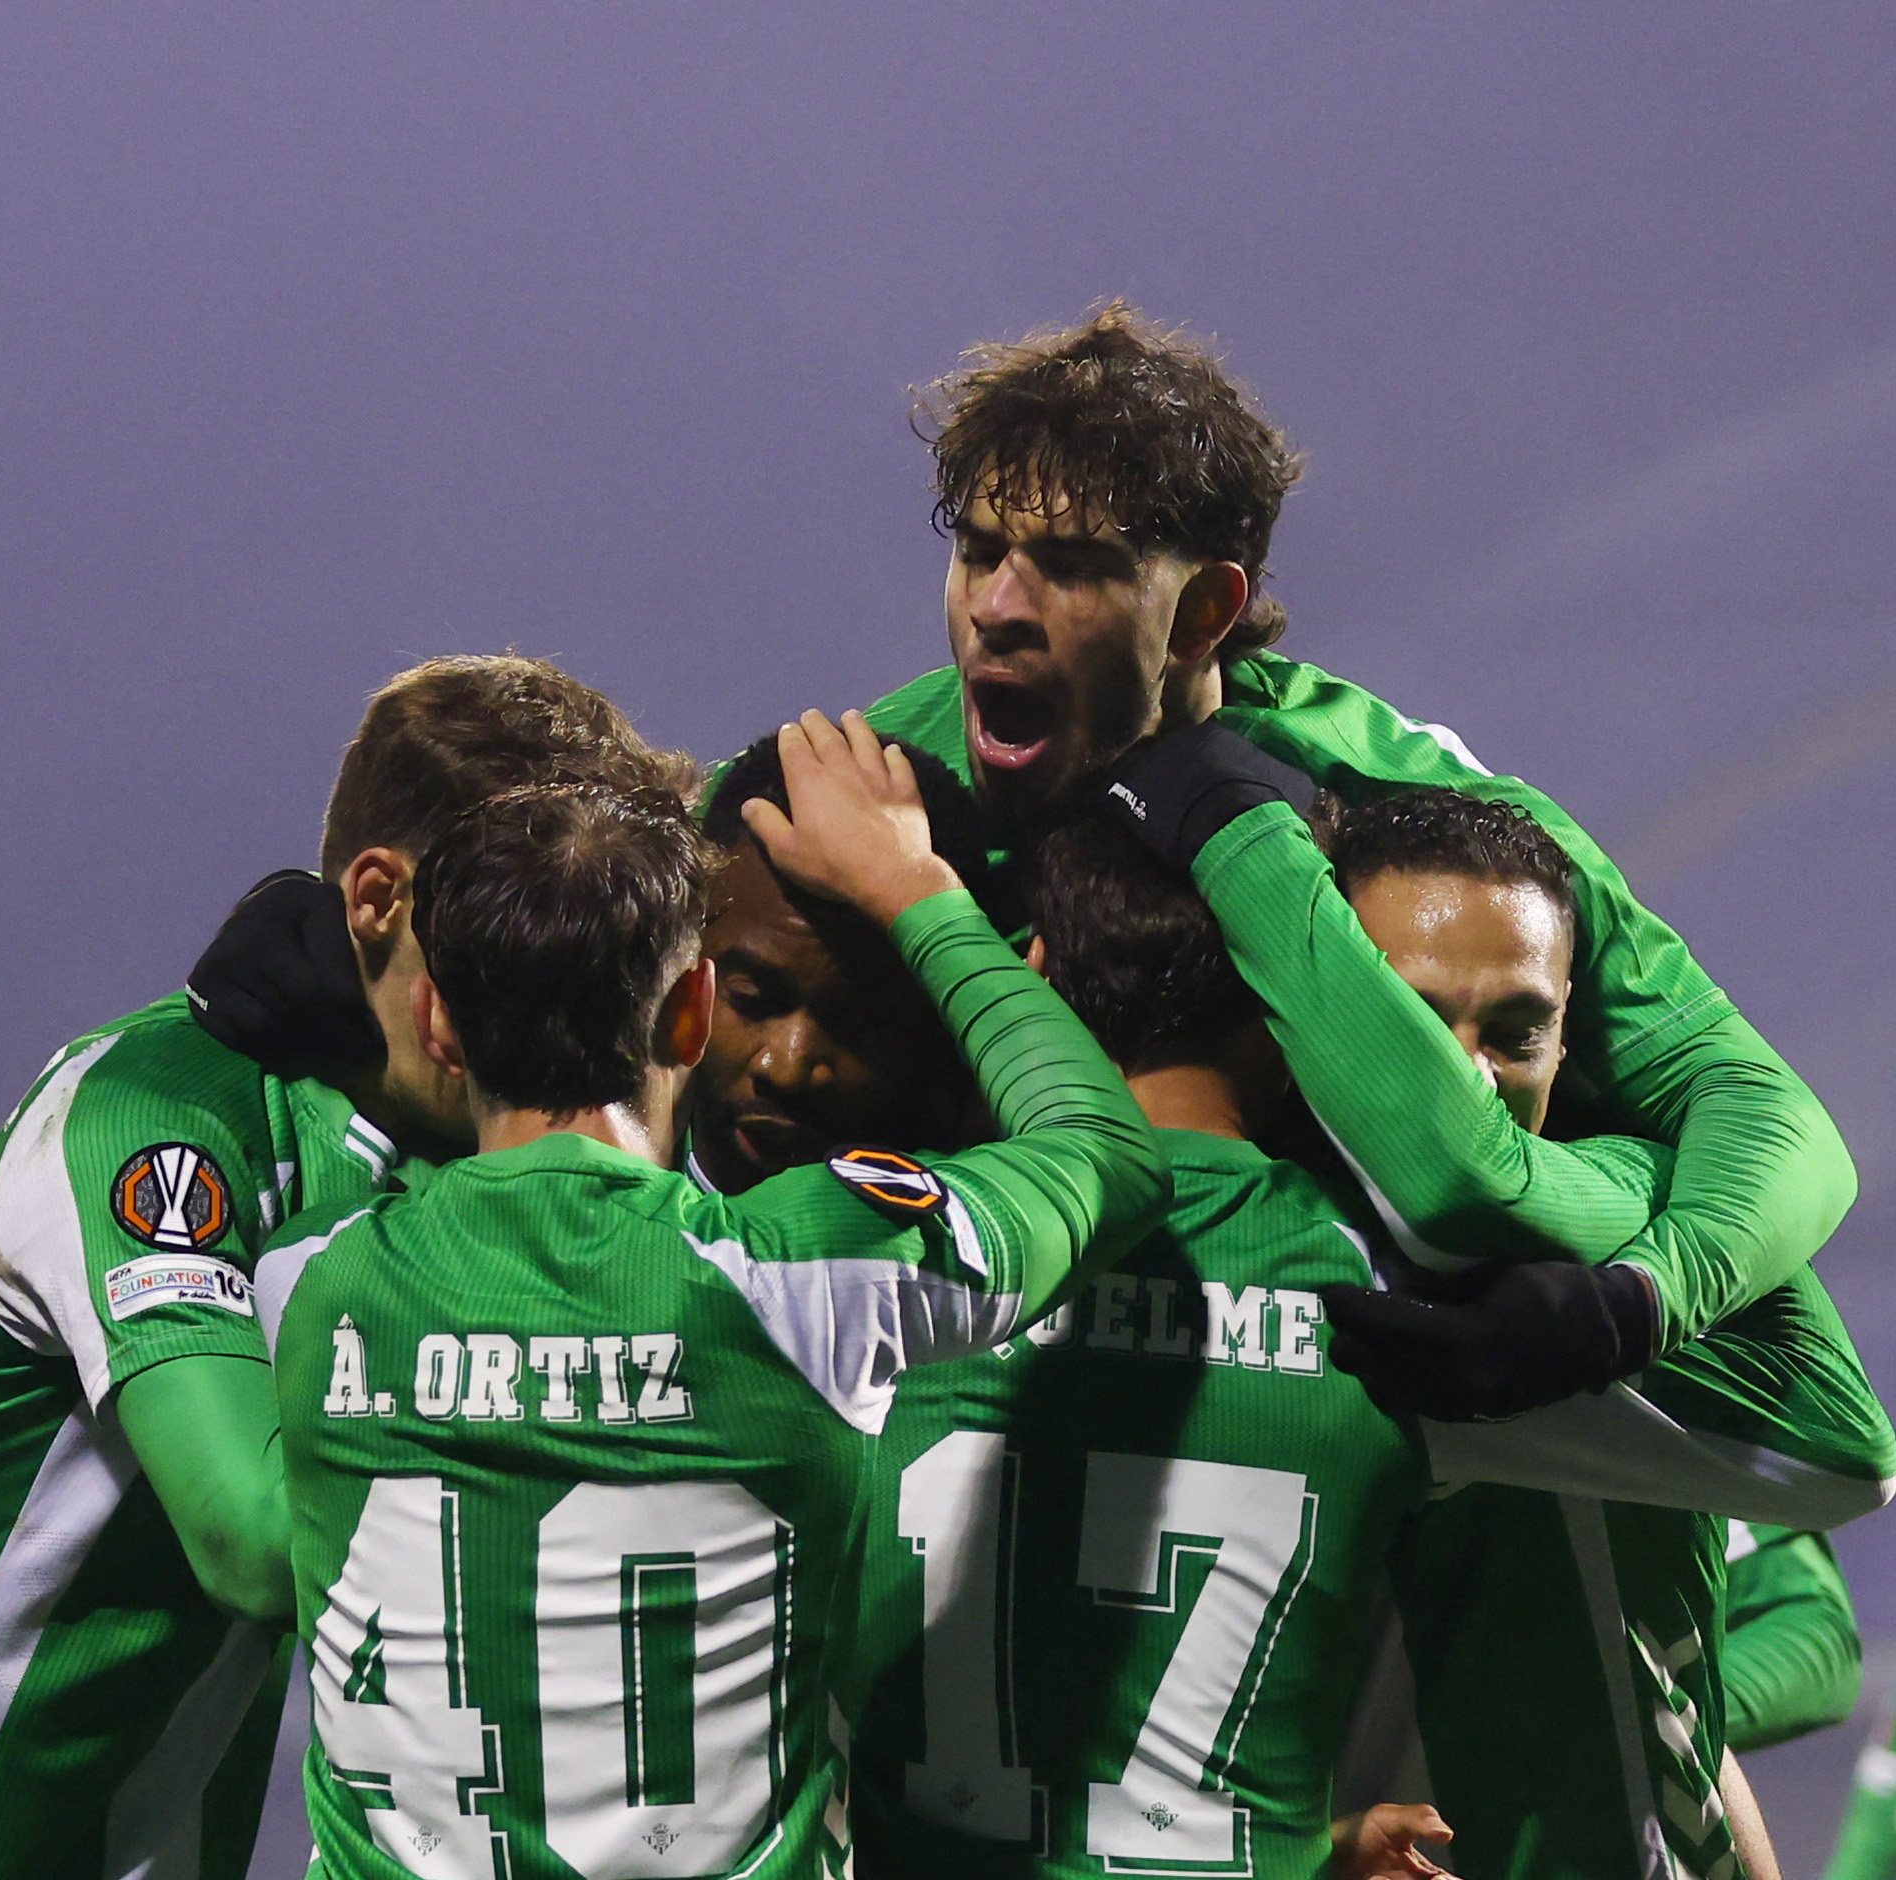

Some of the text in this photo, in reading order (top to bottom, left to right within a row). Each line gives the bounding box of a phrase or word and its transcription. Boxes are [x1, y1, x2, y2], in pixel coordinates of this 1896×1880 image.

[108, 1267, 132, 1283] UEFA
[110, 1271, 214, 1301] FOUNDATION
[414, 1333, 694, 1424] ORTIZ
[898, 1430, 1319, 1878] 17
